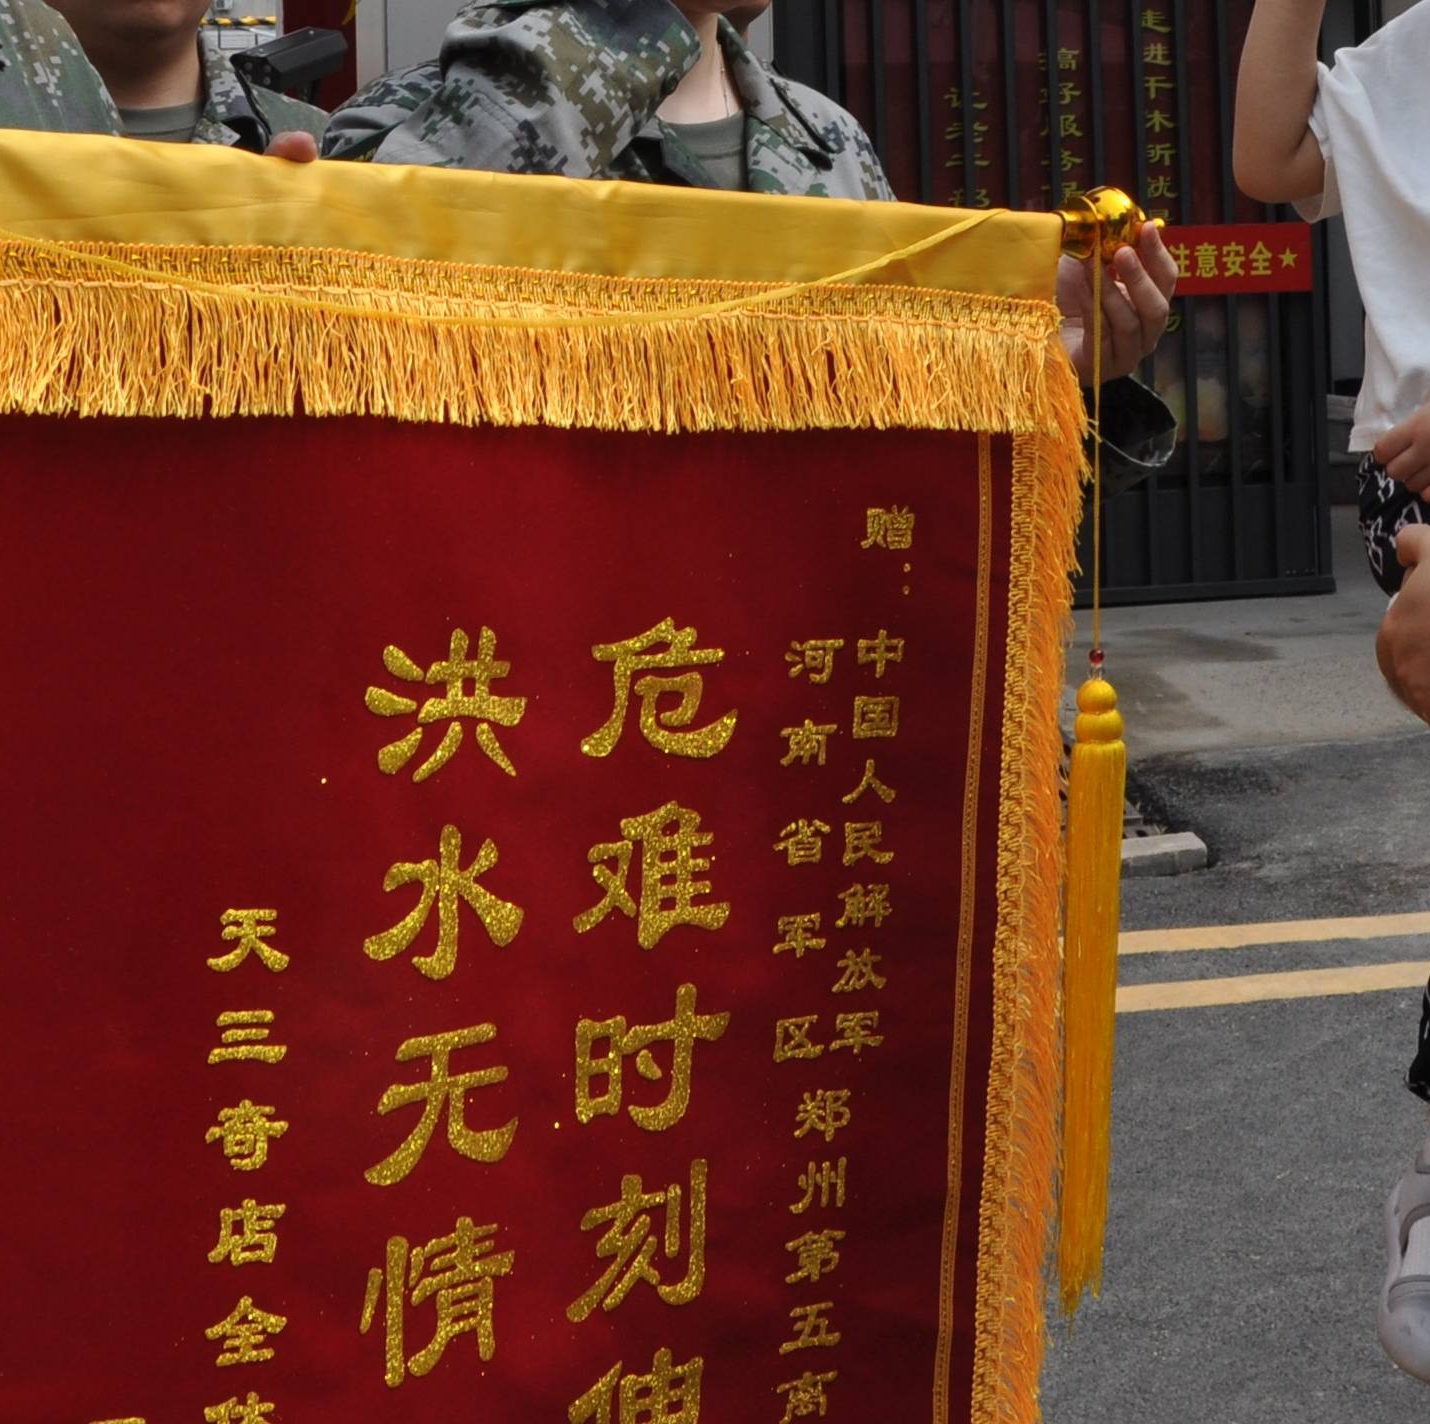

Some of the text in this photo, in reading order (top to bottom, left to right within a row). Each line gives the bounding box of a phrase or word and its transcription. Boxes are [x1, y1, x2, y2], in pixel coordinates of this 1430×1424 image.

[1168, 240, 1274, 279] 注意安全
[362, 624, 528, 1388] 洪水无情
[566, 616, 739, 1424] 危难时刻伸
[772, 638, 846, 1063] 河南省军区
[830, 629, 906, 1054] 中国人民解放军
[777, 1087, 852, 1424] 郑州第五离
